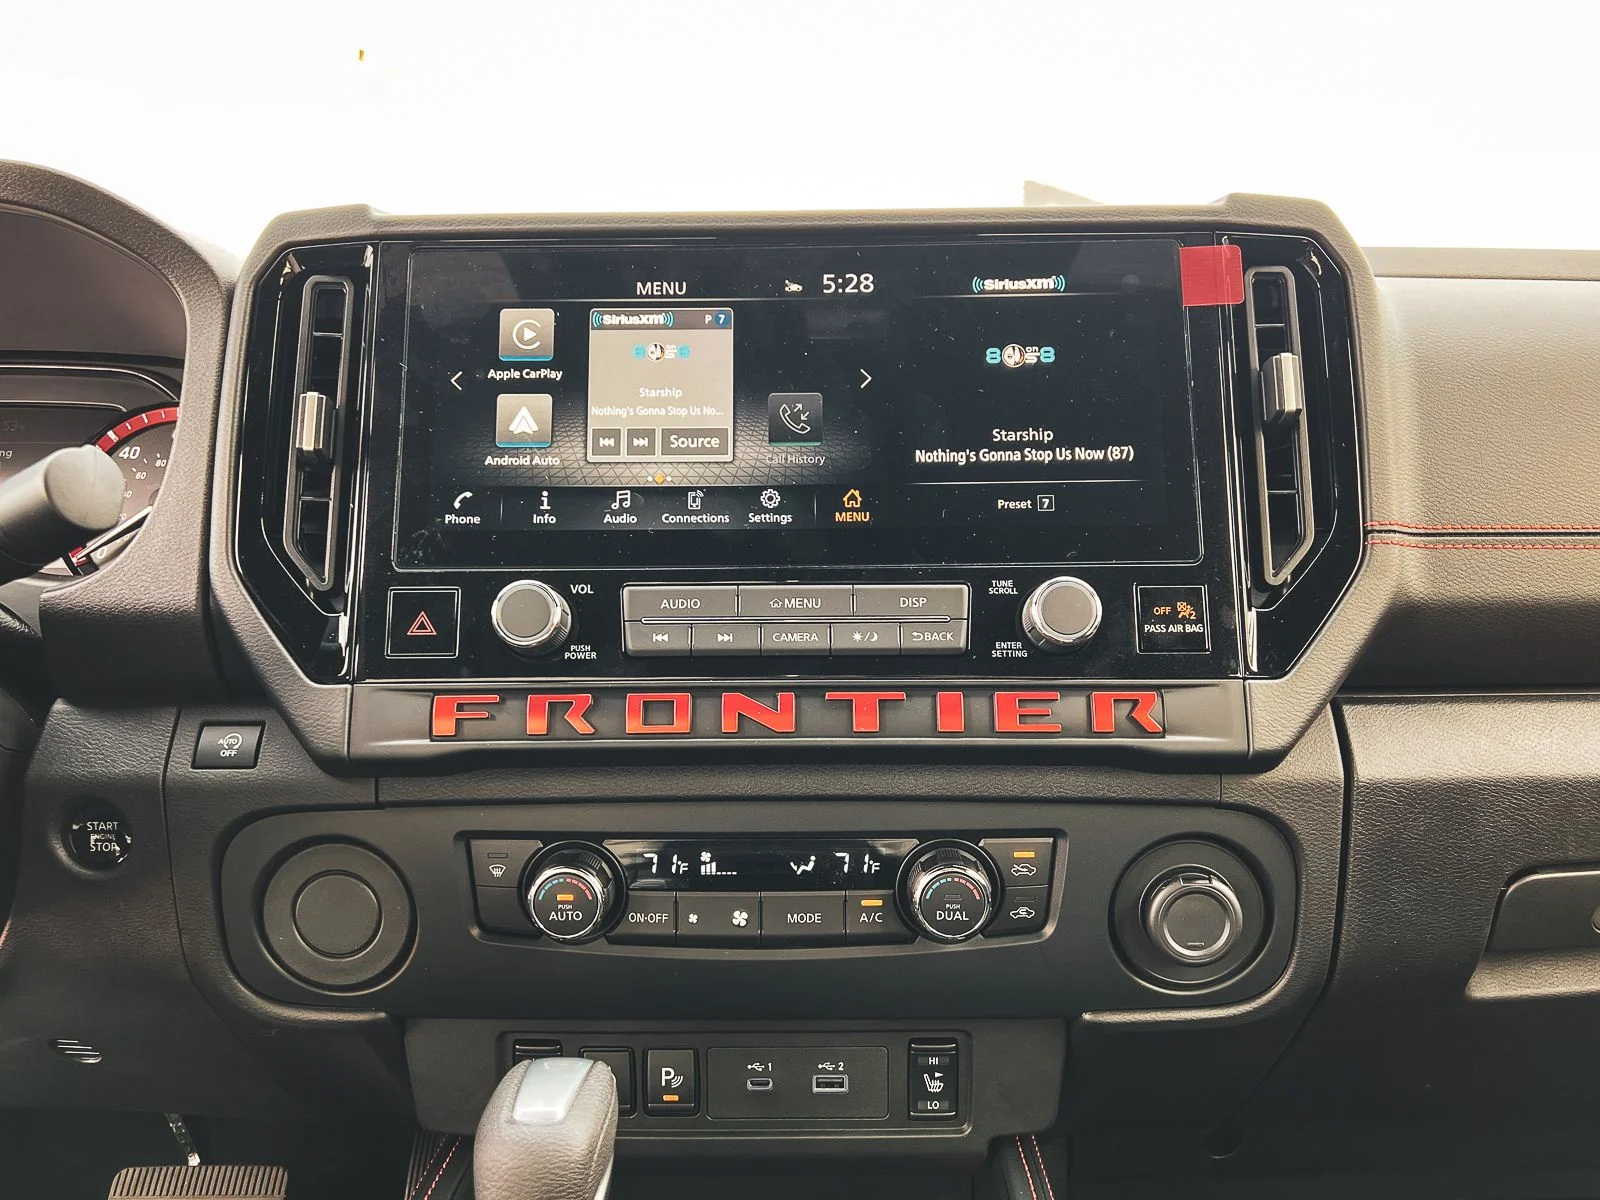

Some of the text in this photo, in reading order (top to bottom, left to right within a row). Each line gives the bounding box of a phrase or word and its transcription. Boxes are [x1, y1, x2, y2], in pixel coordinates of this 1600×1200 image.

[636, 281, 687, 295] MENU
[822, 273, 875, 293] 5:28
[704, 314, 726, 324] P 7
[487, 369, 563, 381] Apple CarPlay
[639, 387, 683, 399] Starship
[591, 405, 634, 418] Nothing's
[636, 405, 666, 415] Gonna
[667, 405, 688, 418] Stop
[690, 405, 702, 415] Us
[669, 434, 720, 448] Source
[992, 428, 1054, 443] Starship
[119, 446, 141, 459] 40
[915, 446, 1134, 464] Nothing's Gonna Stop Us Now (87)
[155, 459, 167, 467] 80
[485, 455, 561, 466] Android Auto
[765, 454, 826, 467] Call History
[135, 471, 147, 480] 60
[997, 499, 1050, 510] Preset 7
[444, 513, 481, 525] Phone
[533, 513, 557, 525] Info
[603, 513, 638, 525] Audio
[661, 512, 730, 524] Connections
[748, 512, 793, 526] Settings
[835, 511, 870, 523] MENU
[570, 584, 594, 595] VOL
[988, 587, 1019, 595] SCROLL
[660, 598, 701, 610] AUDIO
[784, 597, 822, 609] MENU
[899, 597, 928, 608] DISP
[1153, 606, 1172, 615] OFF
[1144, 624, 1204, 633] PASS AIR BAG
[772, 631, 819, 643] CAMERA
[924, 631, 954, 642] BACK
[564, 652, 597, 660] POWER
[991, 649, 1028, 658] SETTING
[432, 691, 1163, 736] FRONTIER
[218, 738, 238, 746] AUTO
[86, 821, 118, 831] START
[90, 842, 117, 852] STOP
[549, 911, 583, 922] AUTO
[787, 913, 822, 924] MODE
[859, 912, 883, 923] A/C
[936, 910, 969, 922] DUAL
[928, 1056, 939, 1065] HI
[837, 1062, 845, 1071] 2
[926, 1101, 940, 1110] LO
